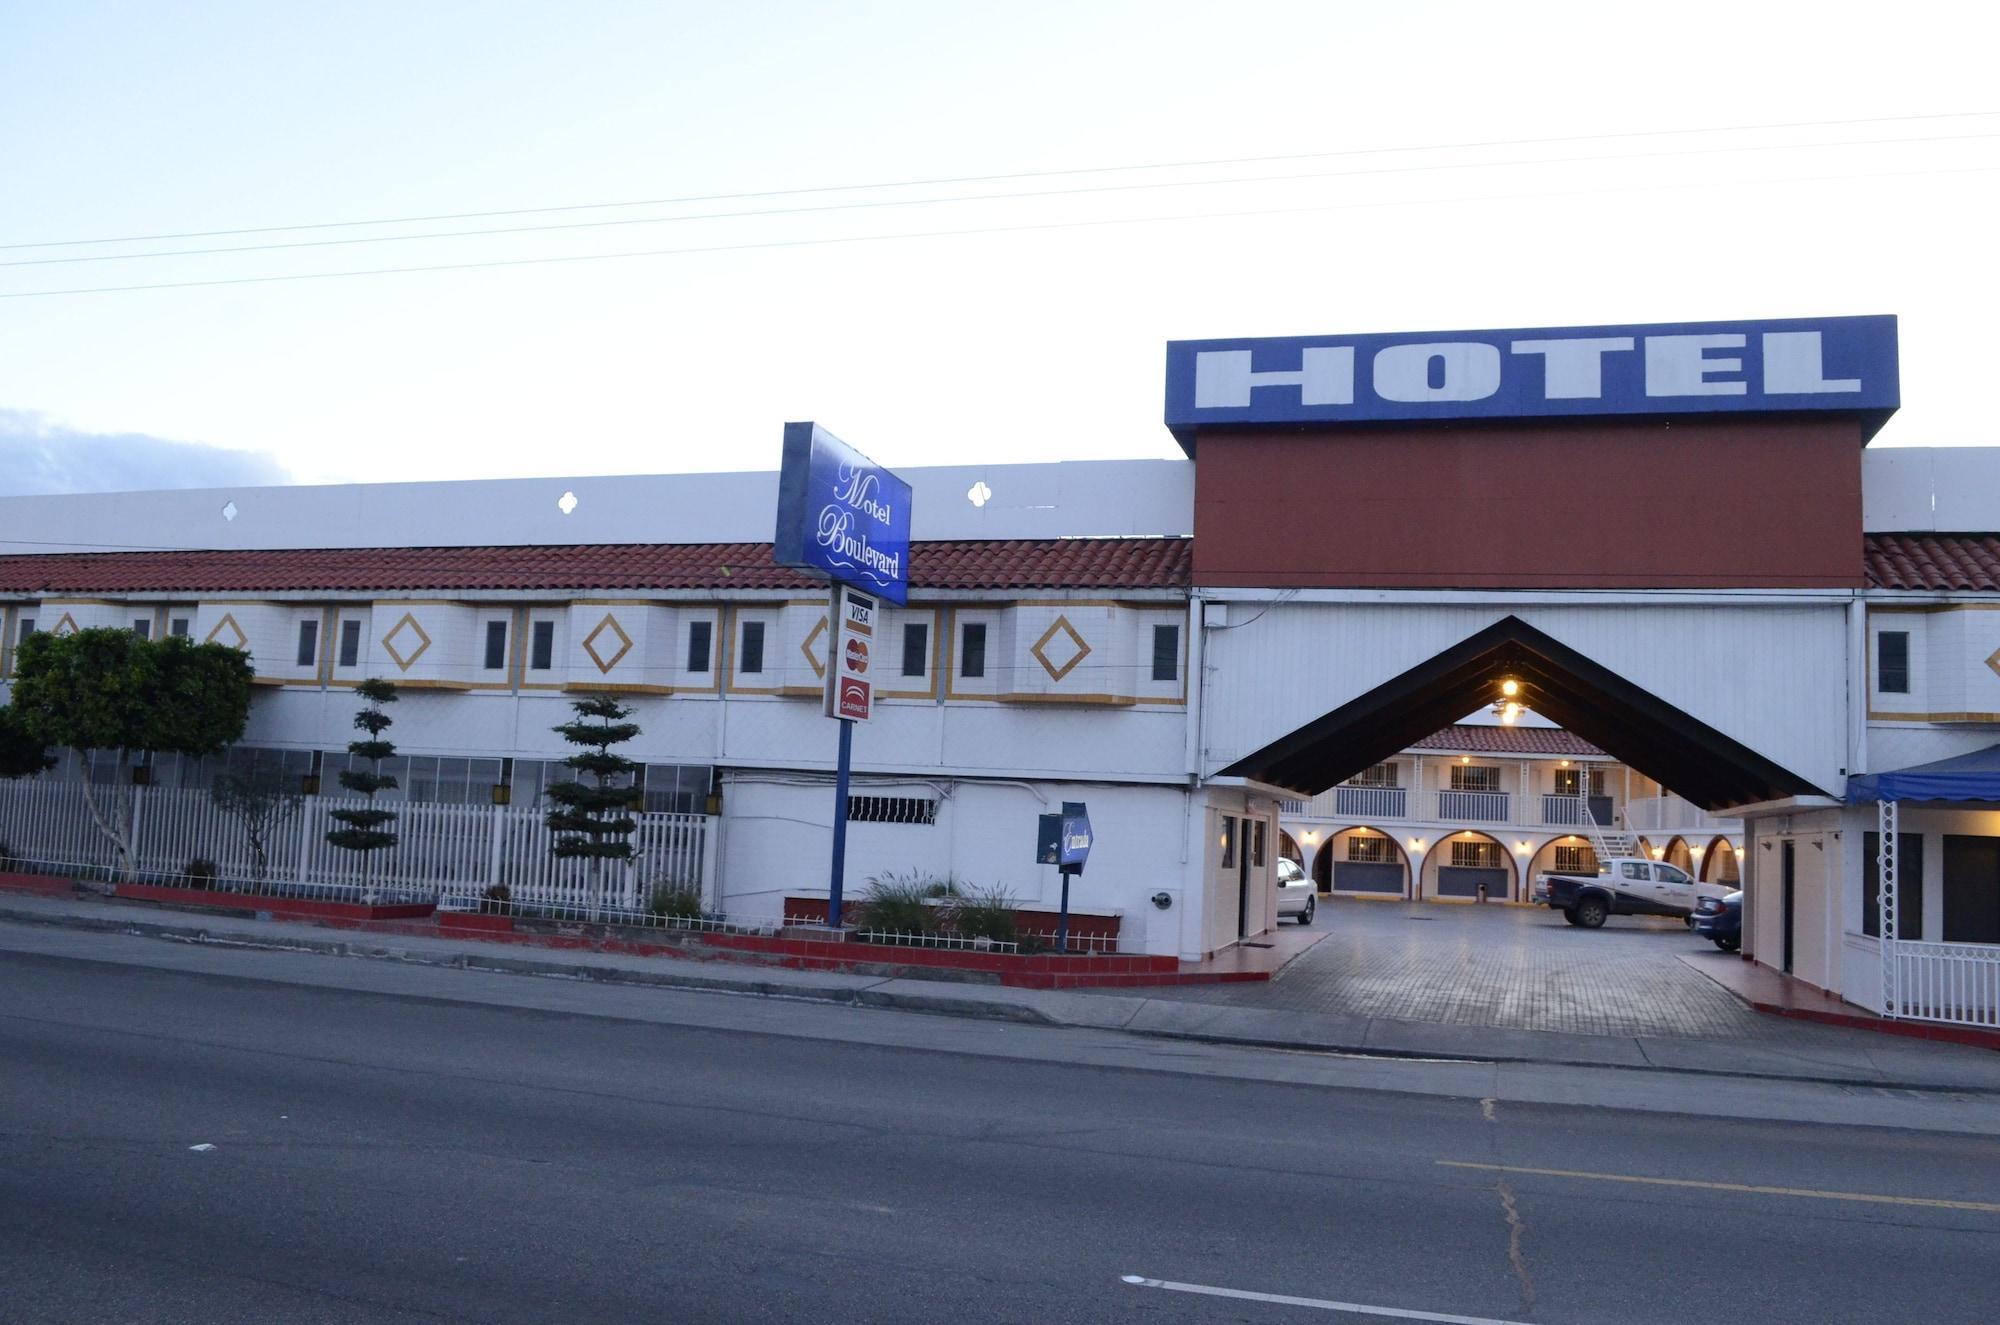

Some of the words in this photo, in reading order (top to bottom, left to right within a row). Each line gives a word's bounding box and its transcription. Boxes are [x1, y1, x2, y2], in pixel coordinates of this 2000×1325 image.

[1196, 331, 1862, 409] HOTEL
[834, 460, 890, 525] Motel
[818, 505, 899, 579] Boulevard
[851, 605, 869, 624] VISA
[841, 700, 868, 713] CARNET
